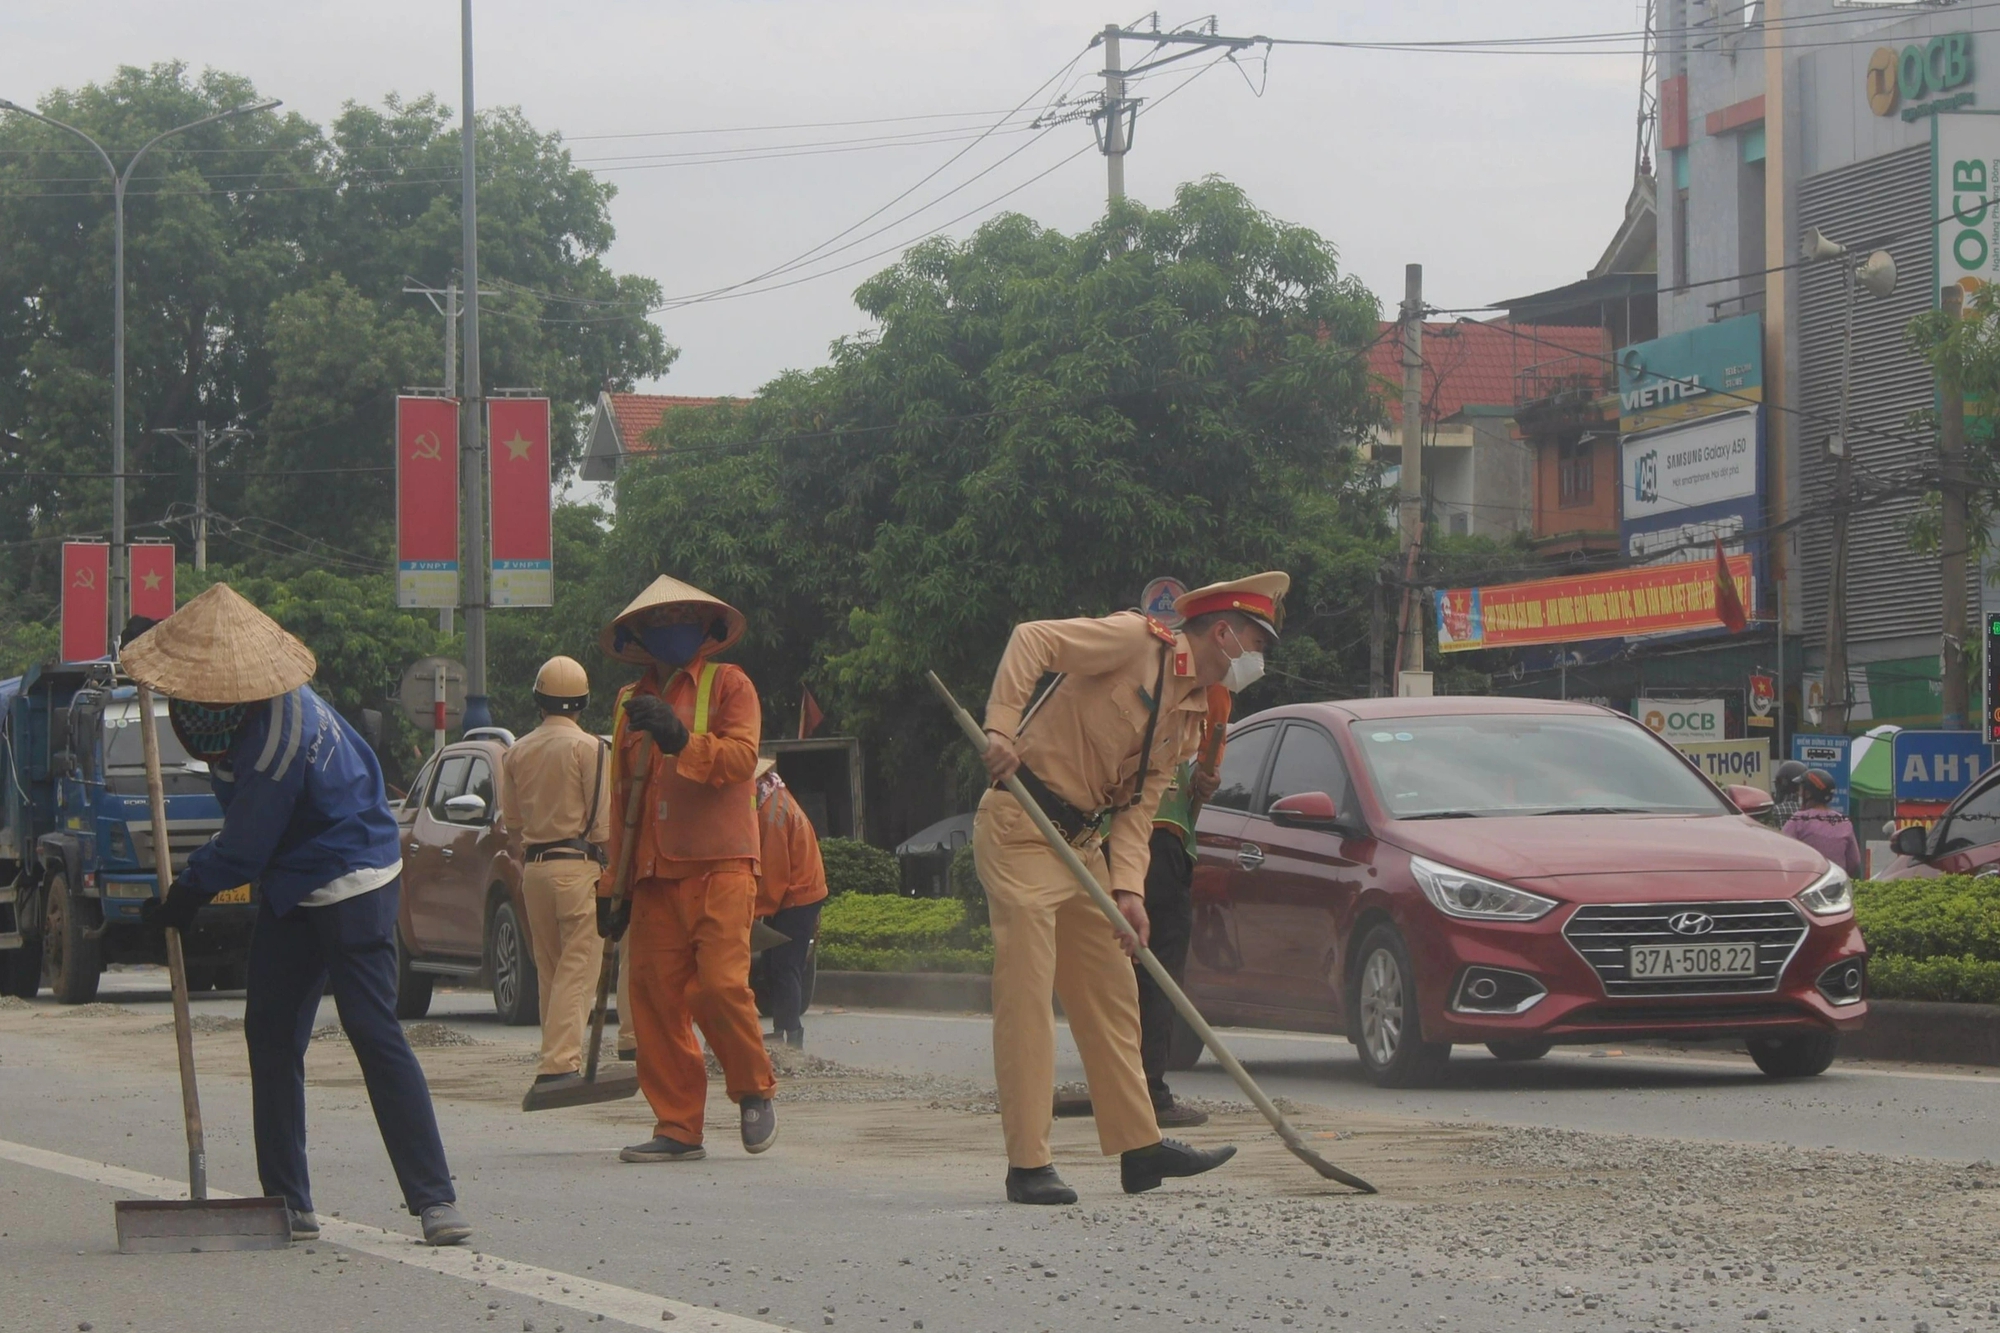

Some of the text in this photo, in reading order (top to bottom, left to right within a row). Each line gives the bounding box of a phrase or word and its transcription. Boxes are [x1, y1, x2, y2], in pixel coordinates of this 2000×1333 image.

[1898, 31, 1970, 99] OCB
[1953, 159, 1987, 270] OCB
[1667, 438, 1747, 470] SAMSUNG Galaxy A50
[1667, 713, 1715, 730] OCB
[1706, 751, 1760, 778] THOẠI
[1903, 754, 1979, 782] AH1
[1635, 948, 1751, 975] 37A-508.22
